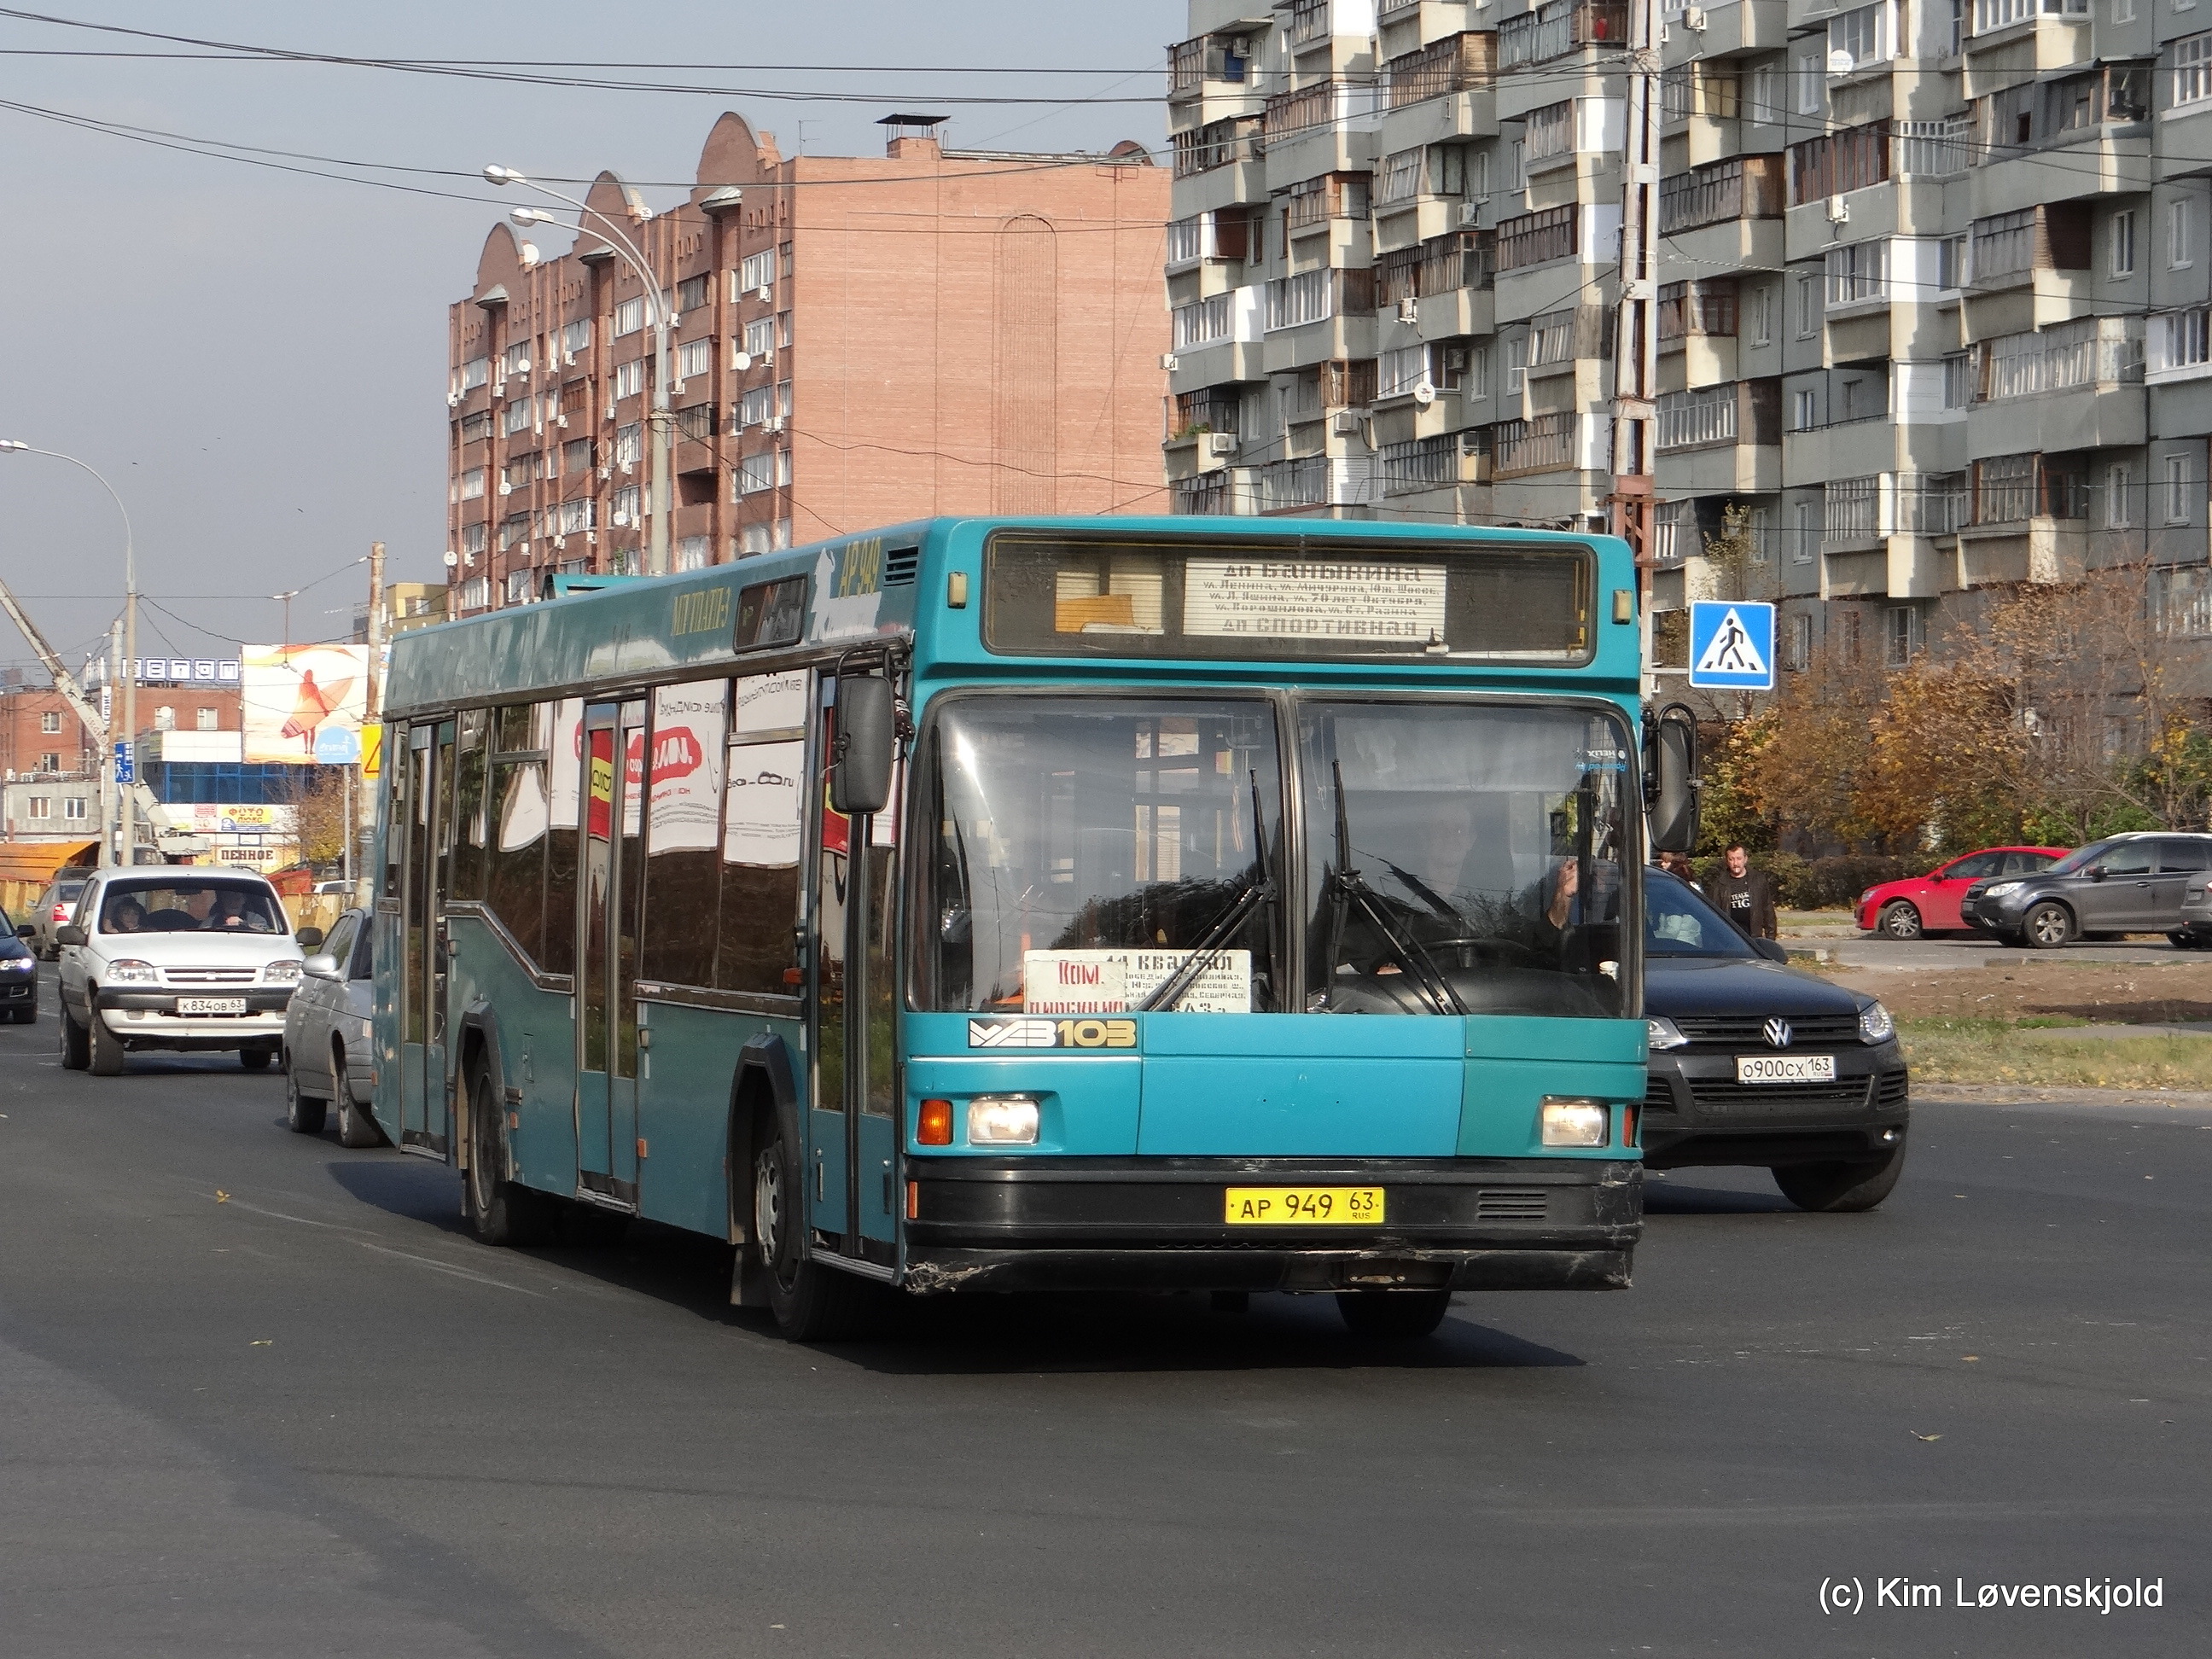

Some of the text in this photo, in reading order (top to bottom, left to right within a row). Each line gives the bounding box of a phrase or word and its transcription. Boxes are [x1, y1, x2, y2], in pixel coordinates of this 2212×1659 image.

[221, 849, 274, 860] ПЕННОЕ
[183, 999, 242, 1011] К834ОВ 63
[1743, 1058, 1830, 1078] О900СХ 163
[1241, 1191, 1373, 1219] АР 949 63
